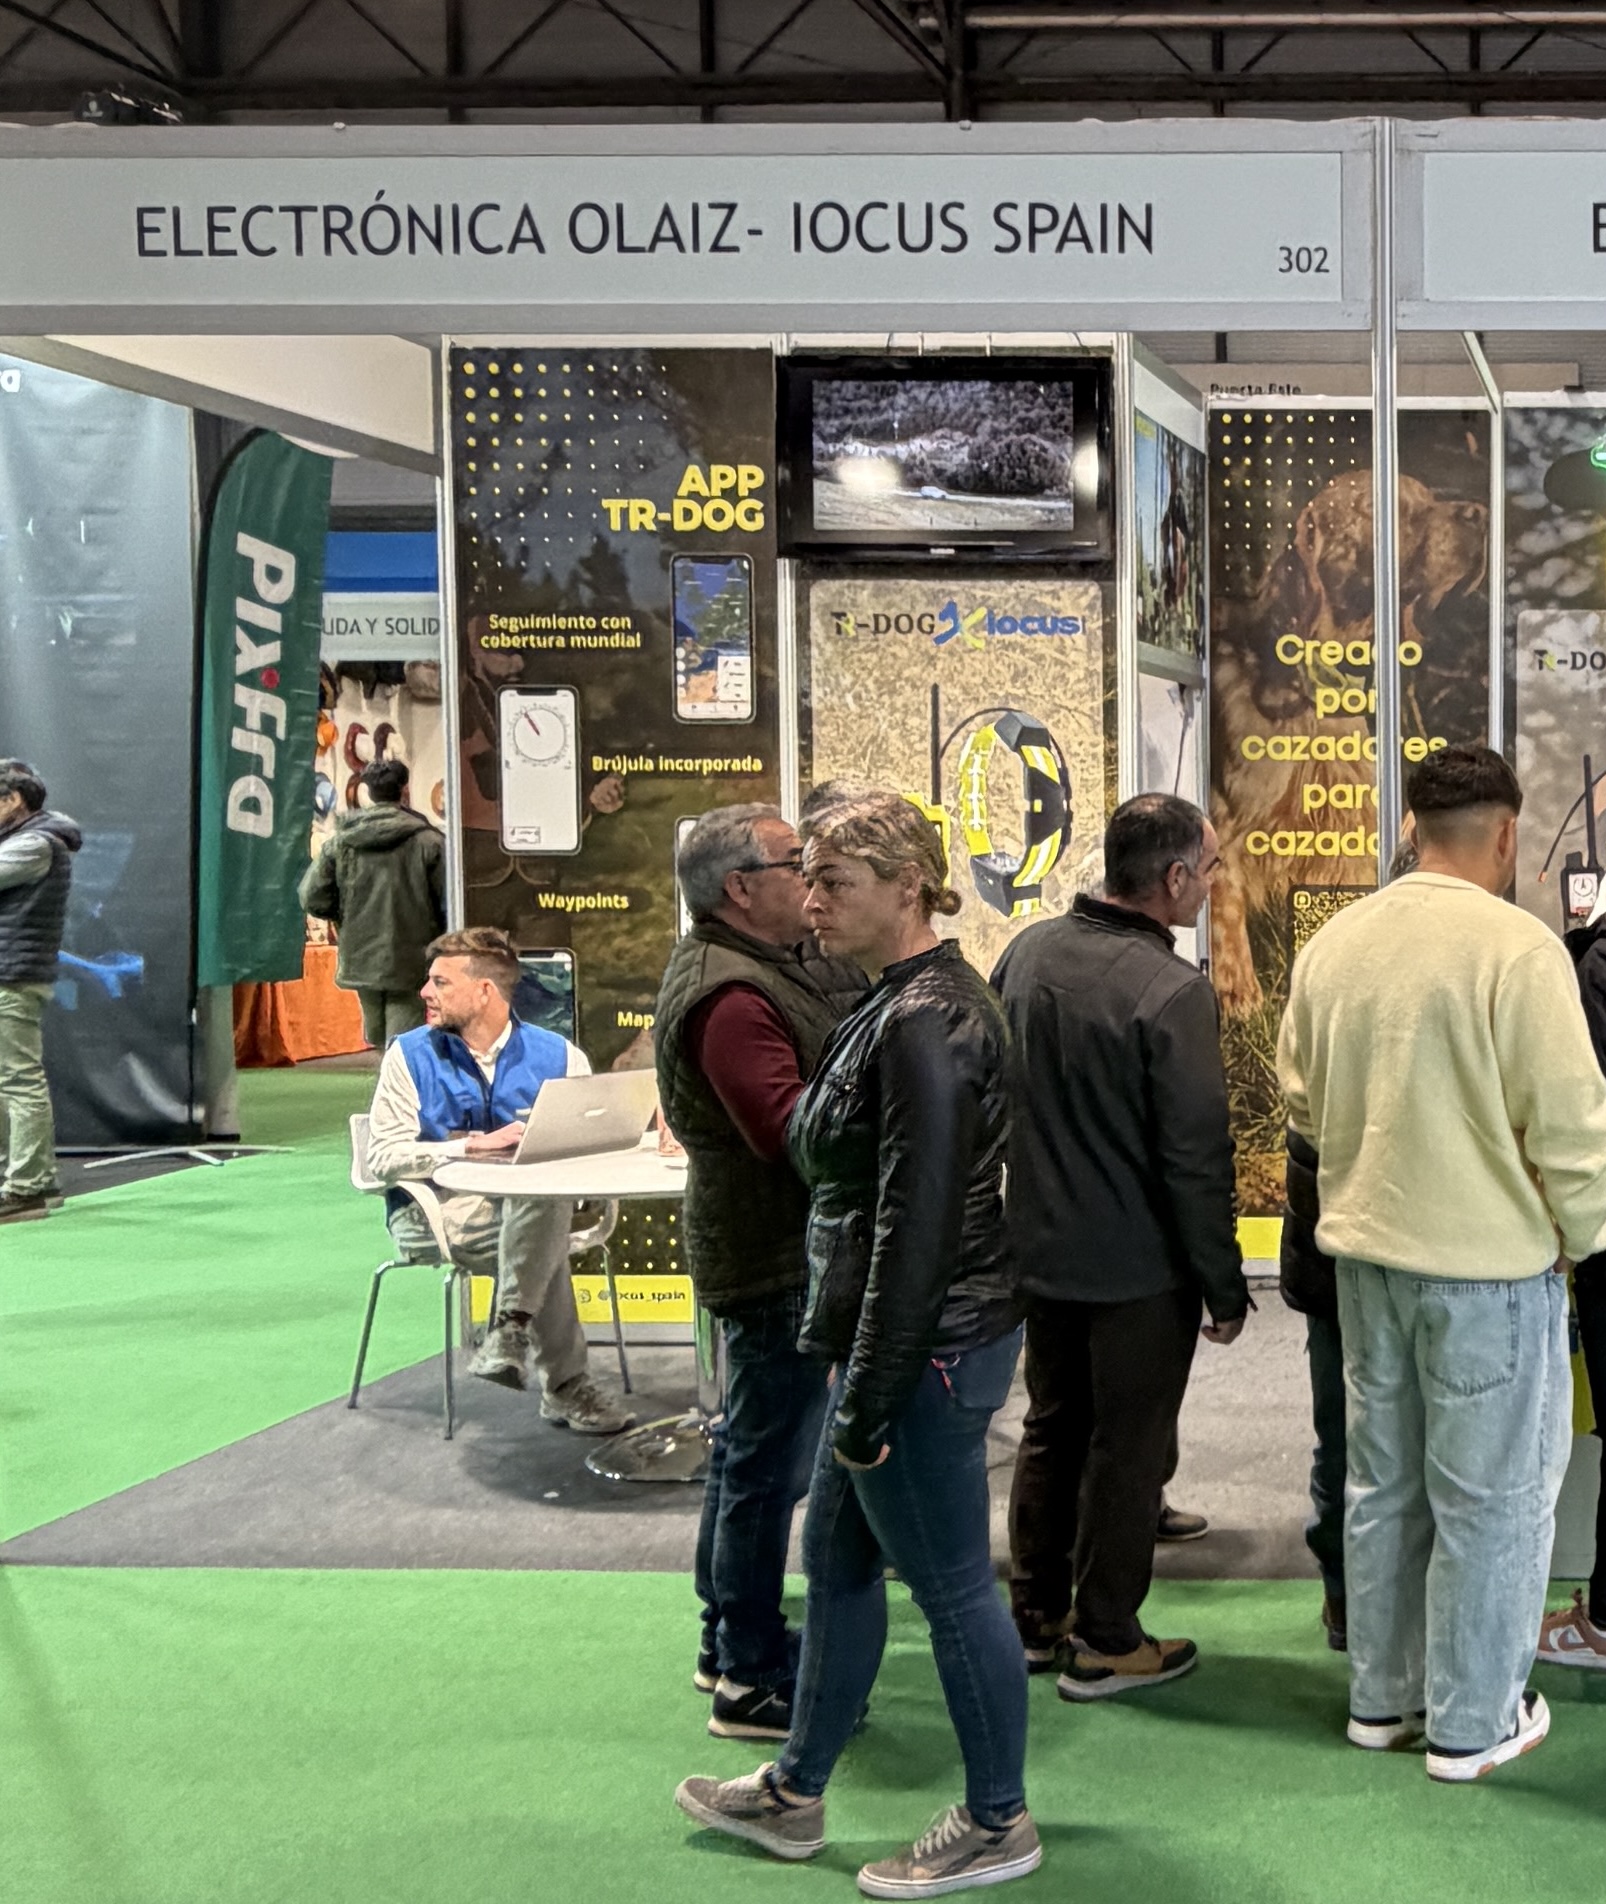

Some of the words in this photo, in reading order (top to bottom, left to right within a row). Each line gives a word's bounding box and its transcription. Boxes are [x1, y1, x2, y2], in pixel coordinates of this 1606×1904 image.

[135, 189, 546, 258] ELECTRÓNICA
[568, 201, 763, 255] OLAIZ-
[793, 200, 969, 255] IOCUS
[992, 200, 1155, 255] SPAIN
[1277, 246, 1331, 274] 302
[677, 464, 765, 497] APP
[601, 498, 765, 532] TR-DOG
[489, 614, 597, 633] Seguimiento
[600, 615, 632, 630] con
[480, 632, 566, 648] cobertura
[570, 632, 641, 649] mundial
[1275, 634, 1423, 667] Creao
[1241, 730, 1448, 763] cazadoes
[591, 755, 655, 775] Brújula
[658, 755, 763, 775] incorporada
[1303, 783, 1379, 815] par
[537, 892, 630, 913] Waypoints
